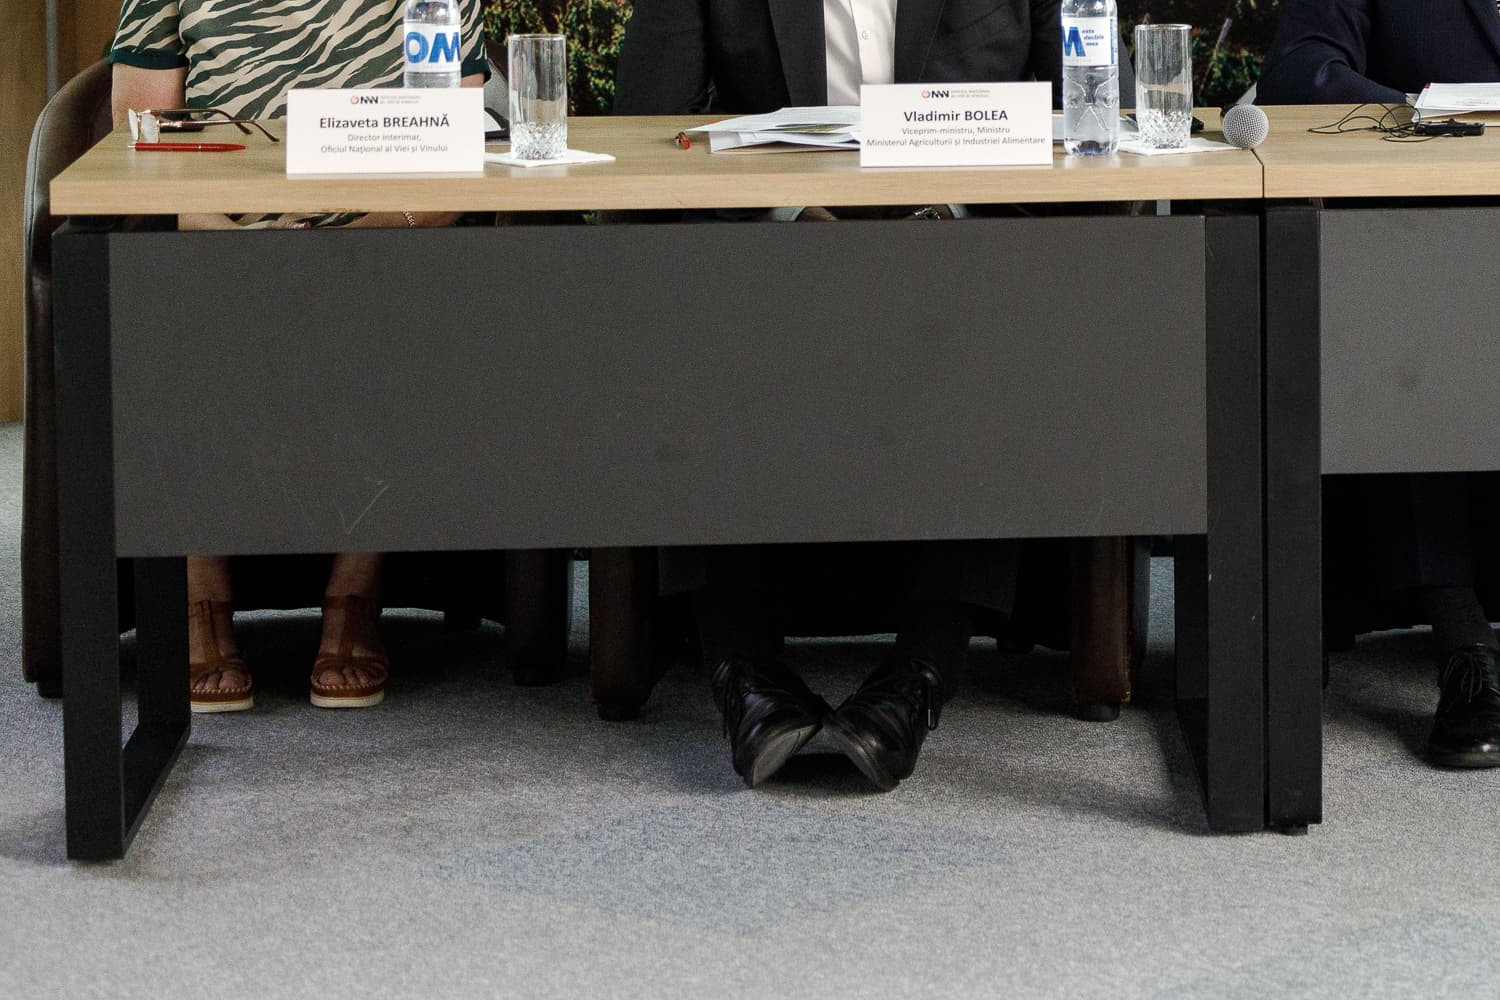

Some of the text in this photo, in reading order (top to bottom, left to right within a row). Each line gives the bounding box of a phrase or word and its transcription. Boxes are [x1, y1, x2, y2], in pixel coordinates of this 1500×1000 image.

[405, 31, 461, 63] OM
[320, 113, 450, 128] Elizaveta BREAHNĂ
[904, 110, 1008, 122] Vladimir BOLEA
[902, 126, 1010, 136] Viceprim-ministru, Ministru
[347, 133, 422, 142] Director interimar,
[867, 138, 907, 146] Ministerul
[909, 138, 953, 147] Agriculturii
[963, 137, 1000, 145] Industriei
[1002, 137, 1045, 145] Alimentare
[321, 145, 347, 153] Oficiul
[385, 145, 393, 153] al
[394, 145, 410, 153] Viei
[420, 144, 448, 153] Vinului
